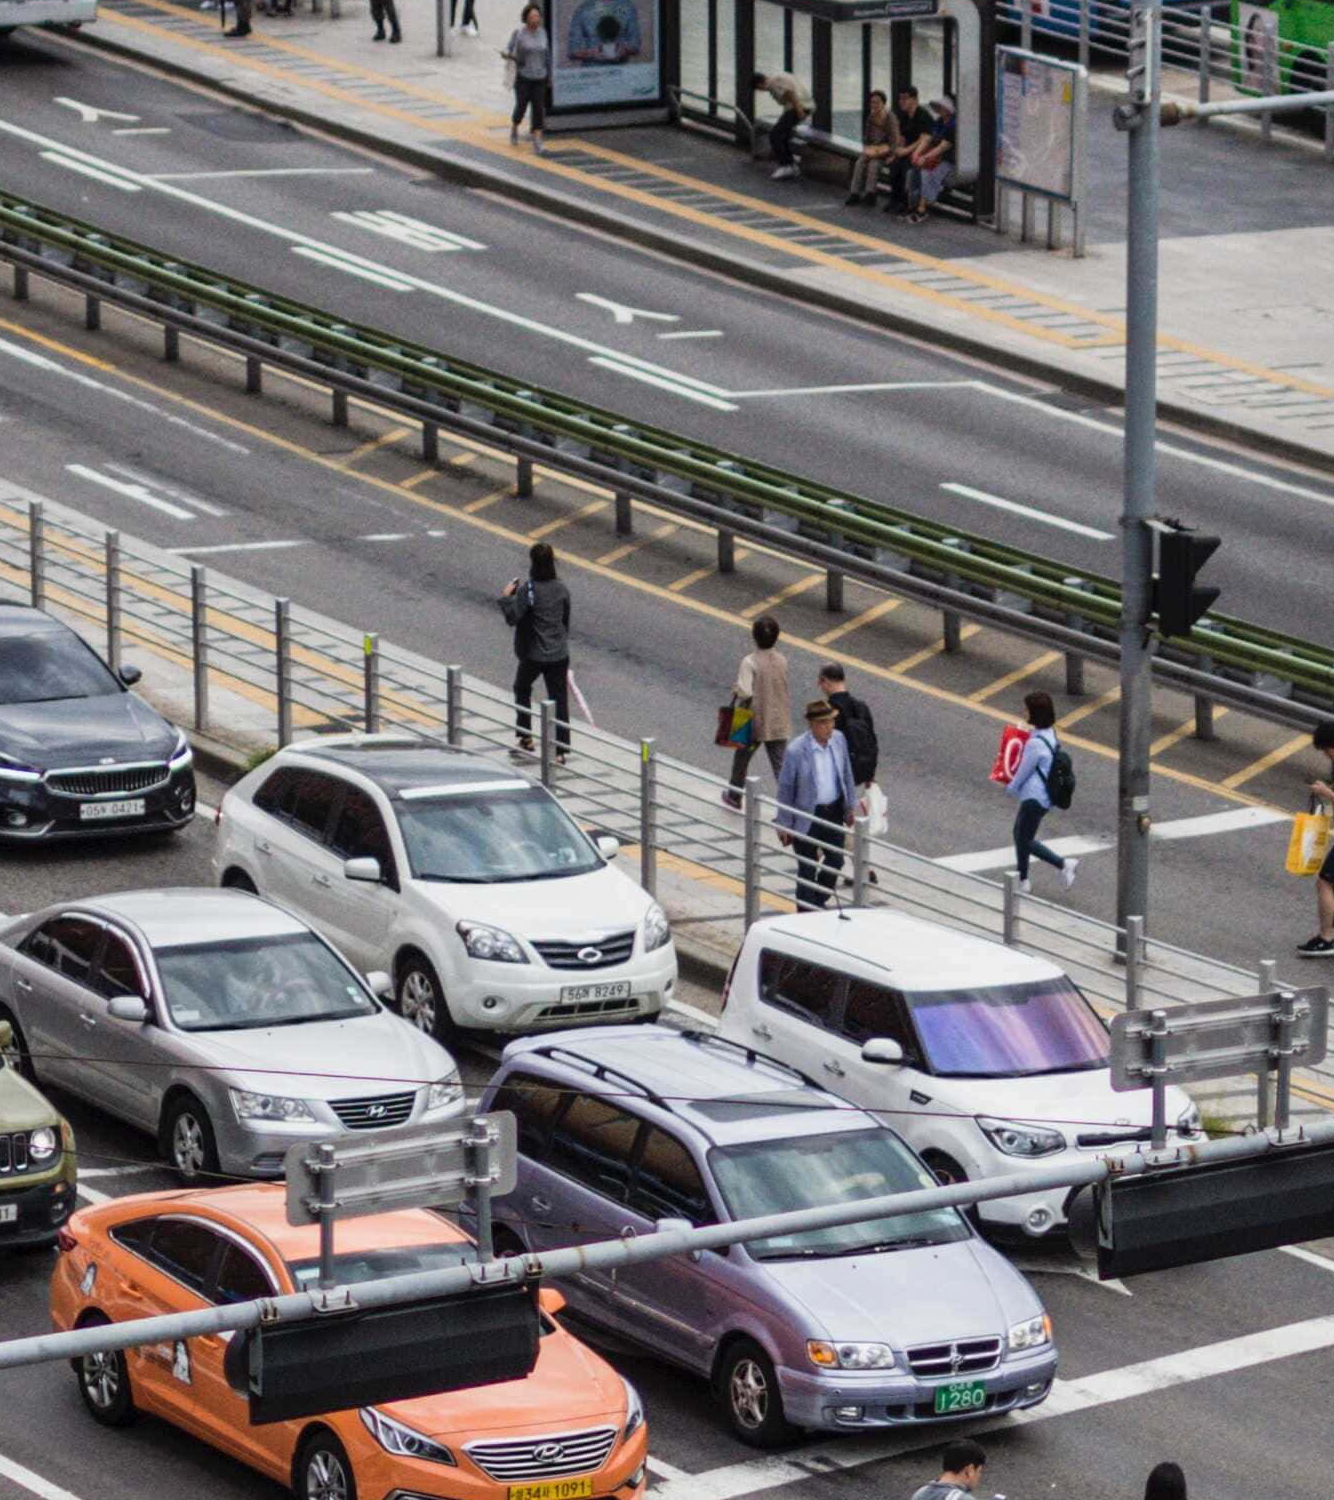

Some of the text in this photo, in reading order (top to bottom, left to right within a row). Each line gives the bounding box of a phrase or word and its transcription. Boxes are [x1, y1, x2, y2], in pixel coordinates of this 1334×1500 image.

[594, 984, 624, 999] 8249
[940, 1388, 985, 1413] 1280
[554, 1480, 586, 1498] 1091
